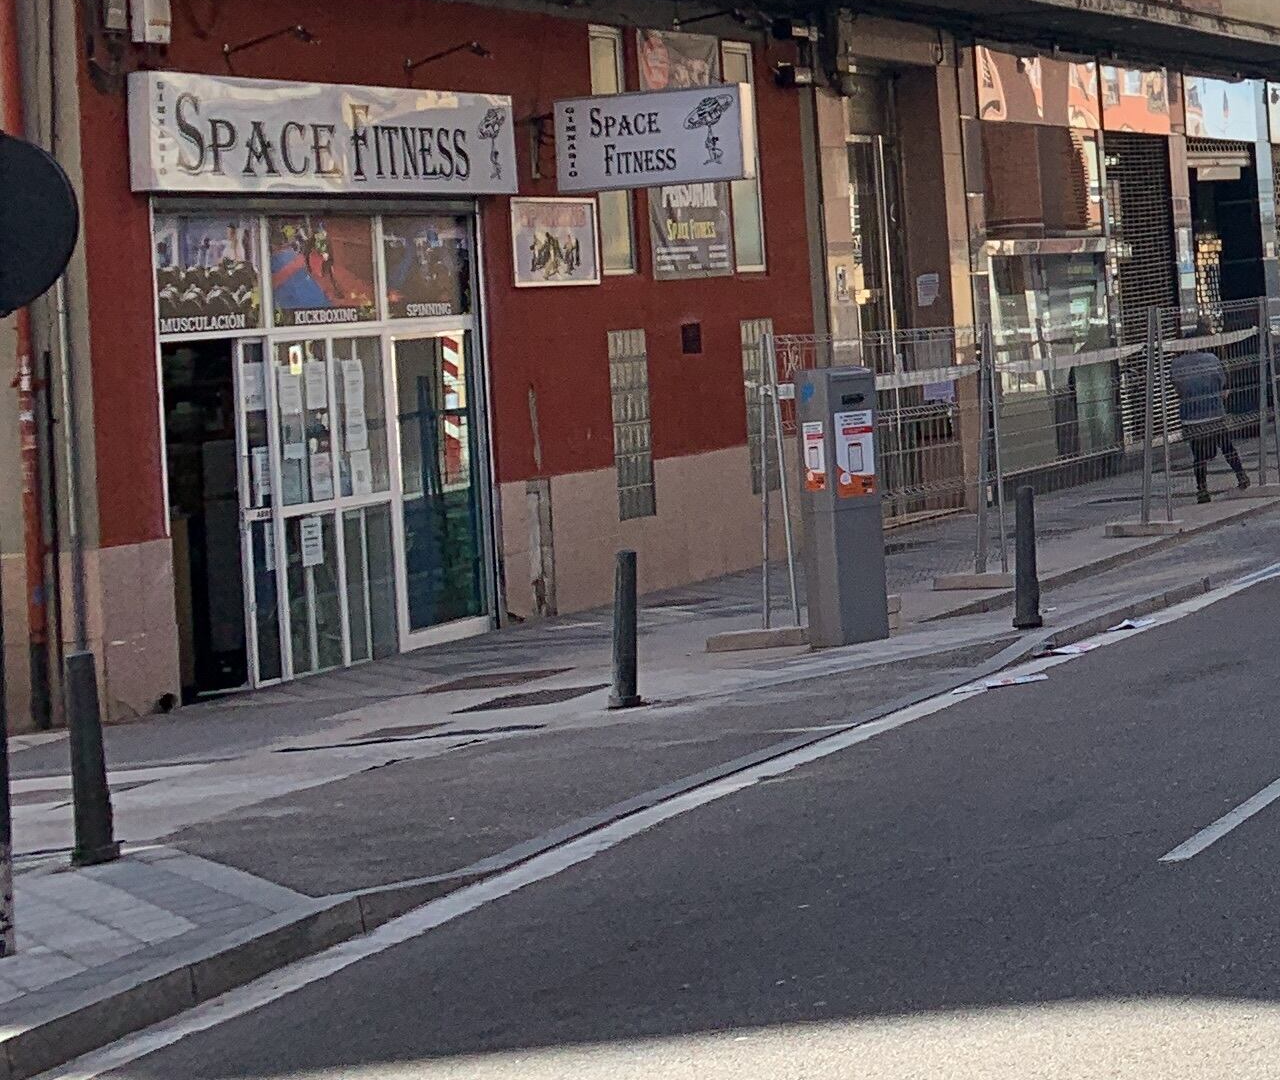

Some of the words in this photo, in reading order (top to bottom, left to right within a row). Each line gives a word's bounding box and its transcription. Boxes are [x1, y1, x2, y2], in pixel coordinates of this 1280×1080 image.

[175, 91, 342, 180] SPACE
[349, 103, 472, 182] FITNESS
[589, 107, 662, 139] SPACE
[564, 106, 579, 178] GIMNASIO
[603, 143, 678, 177] FITNESS
[160, 312, 246, 333] MUSCULACIÓN
[294, 308, 359, 325] KICKBOXING
[406, 303, 452, 317] SPINNING
